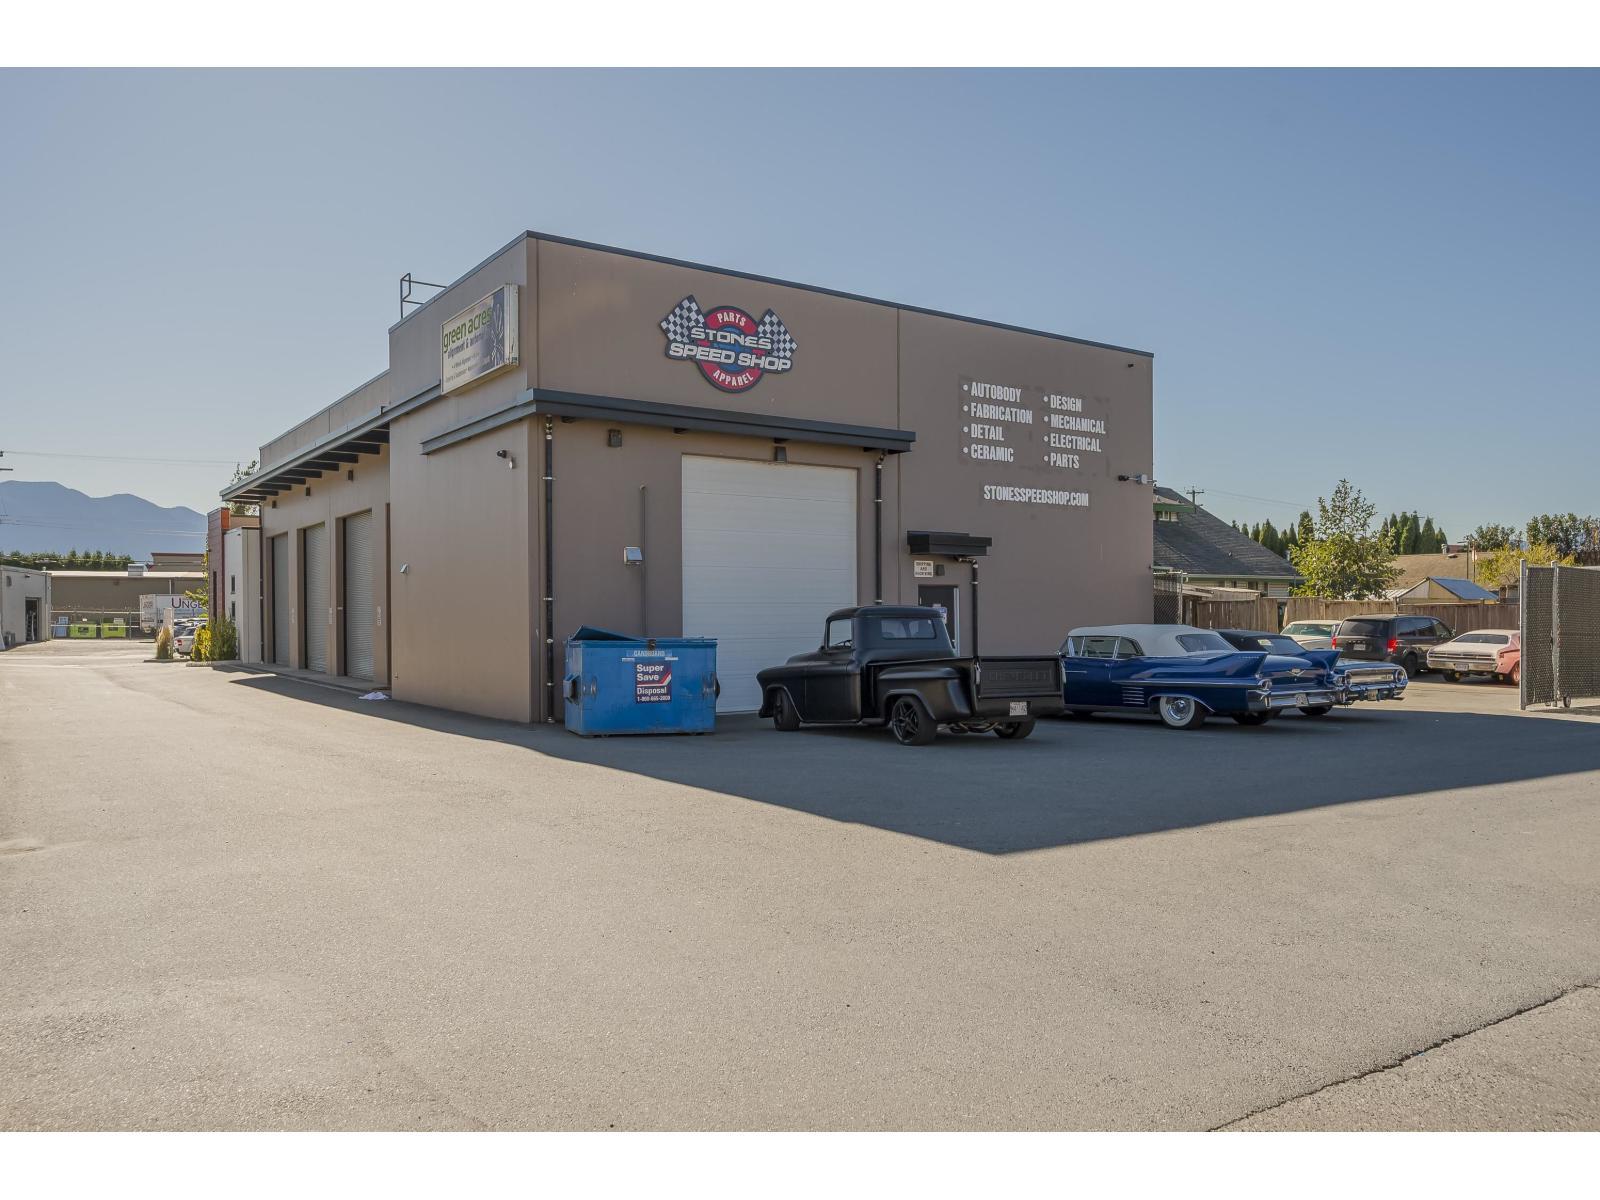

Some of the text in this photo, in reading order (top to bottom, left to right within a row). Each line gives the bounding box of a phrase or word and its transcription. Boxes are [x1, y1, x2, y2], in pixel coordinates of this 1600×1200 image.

[717, 312, 746, 327] PARTS
[443, 321, 467, 353] green
[467, 308, 493, 333] acres
[691, 327, 772, 349] STONES
[669, 342, 793, 371] SPEED SHOP
[712, 369, 754, 386] APPAREL
[970, 381, 1022, 403] AUTOBODY
[1050, 394, 1082, 412] DESIGN
[970, 402, 1033, 424] FABRICATION
[970, 423, 1005, 441] DETAIL
[1050, 414, 1106, 434] MECHANICAL
[1050, 433, 1102, 452] ELECTRICAL
[970, 444, 1014, 463] CERAMIC
[1050, 452, 1080, 469] PARTS
[983, 485, 1089, 507] STONESSPEEDSHOP.COM
[636, 663, 664, 674] Super
[636, 673, 660, 682] Save
[637, 687, 667, 696] Disposal
